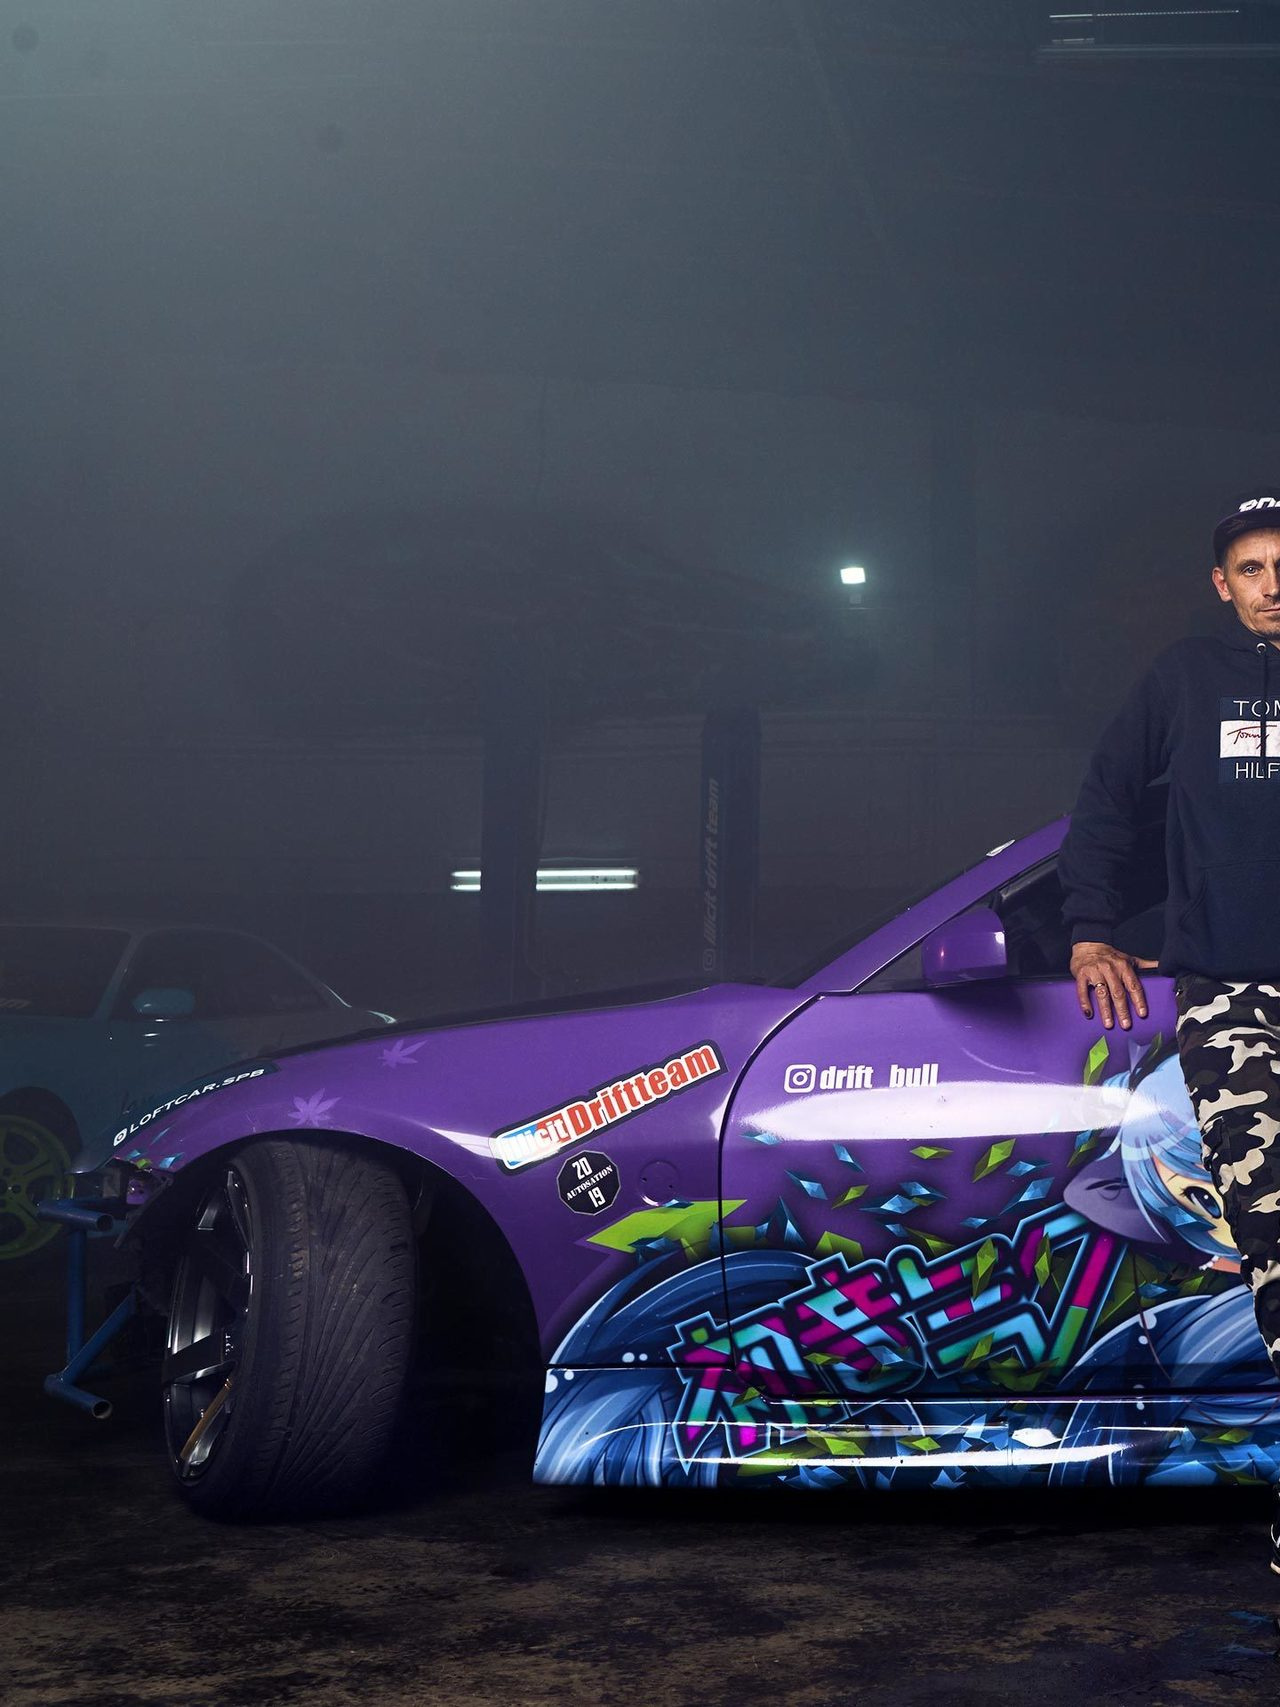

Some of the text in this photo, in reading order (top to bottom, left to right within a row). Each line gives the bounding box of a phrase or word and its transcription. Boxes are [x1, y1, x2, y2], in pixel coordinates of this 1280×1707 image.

[129, 1068, 265, 1134] LOFTCAR.SPB
[566, 1046, 718, 1138] Driftteam
[566, 1164, 614, 1201] AUTOSATION
[572, 1156, 593, 1180] 20
[587, 1186, 606, 1208] 19
